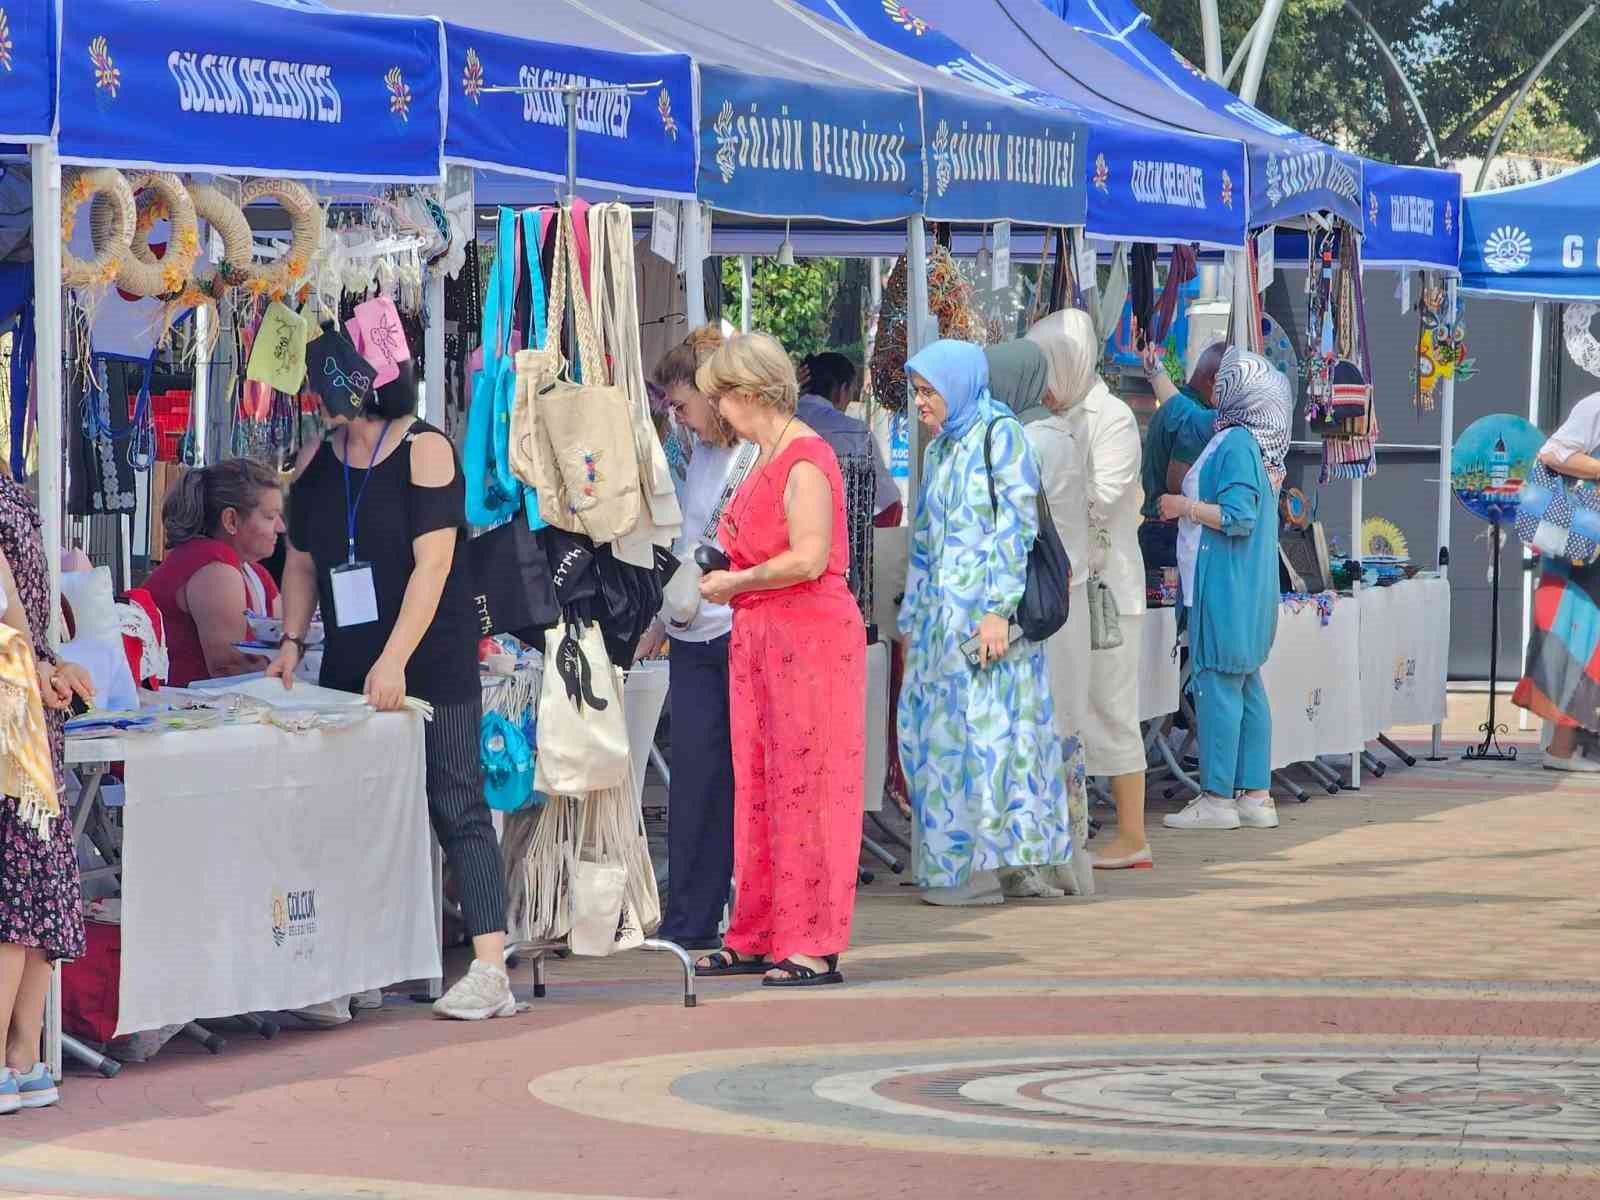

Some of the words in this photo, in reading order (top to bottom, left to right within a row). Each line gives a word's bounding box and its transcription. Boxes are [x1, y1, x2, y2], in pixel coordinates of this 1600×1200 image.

[168, 51, 248, 114] GÖLCÜK
[239, 57, 341, 123] BELEDİYESİ
[737, 103, 803, 170] GÖLCÜK
[812, 120, 905, 182] BELEDİYESİ
[950, 120, 1000, 181] GÖLCÜK
[1007, 128, 1075, 187] BELEDİYESİ
[1562, 234, 1600, 269] G
